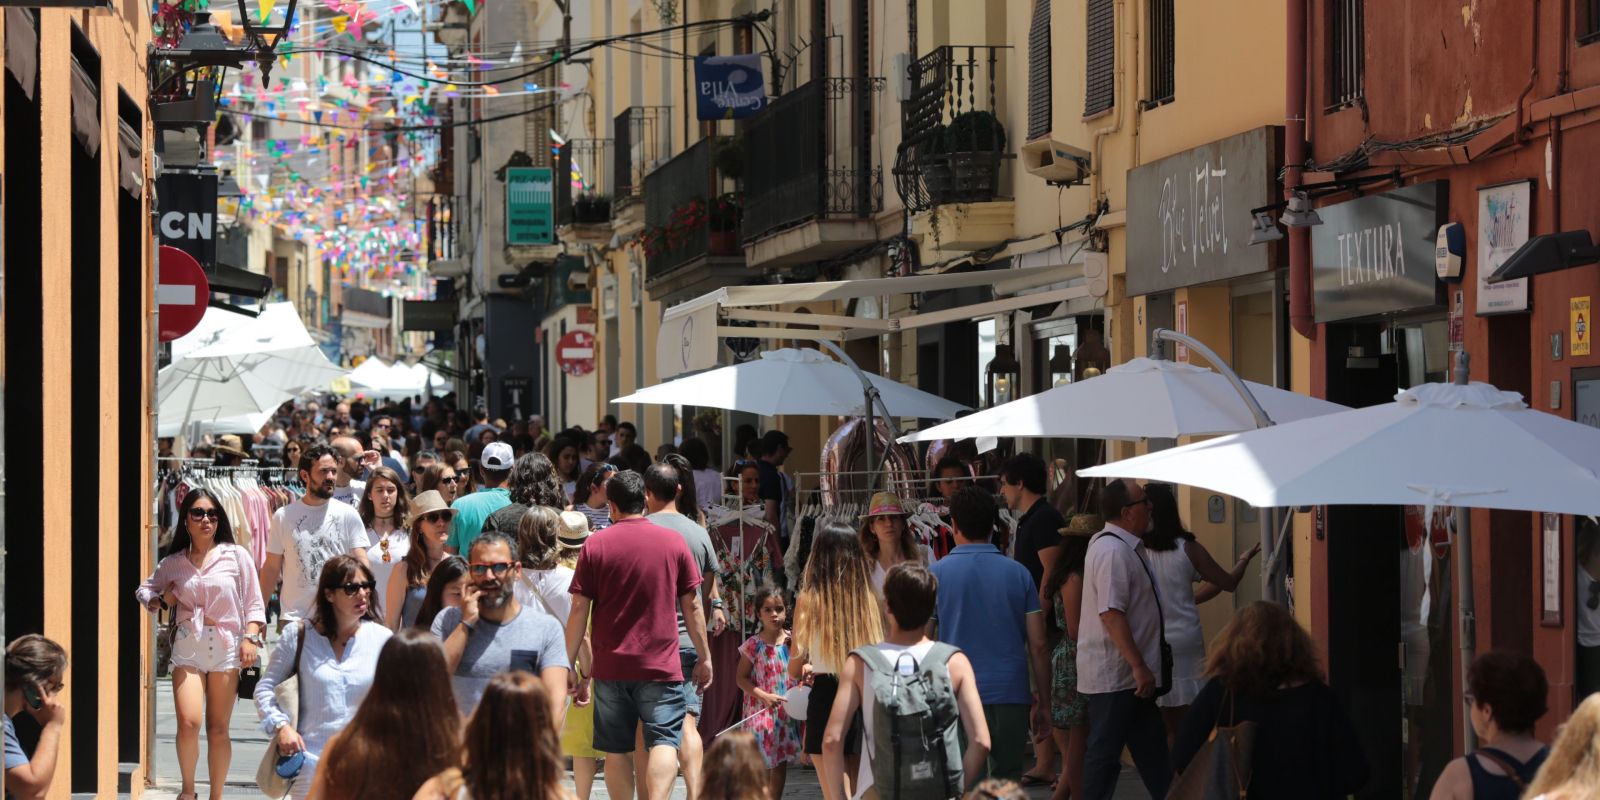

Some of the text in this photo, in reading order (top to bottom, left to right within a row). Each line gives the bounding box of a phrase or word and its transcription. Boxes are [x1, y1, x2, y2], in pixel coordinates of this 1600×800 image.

[701, 81, 738, 100] Vila
[161, 211, 212, 240] CN
[1159, 155, 1228, 273] Blue Velvet
[1338, 222, 1405, 287] TEXTURA
